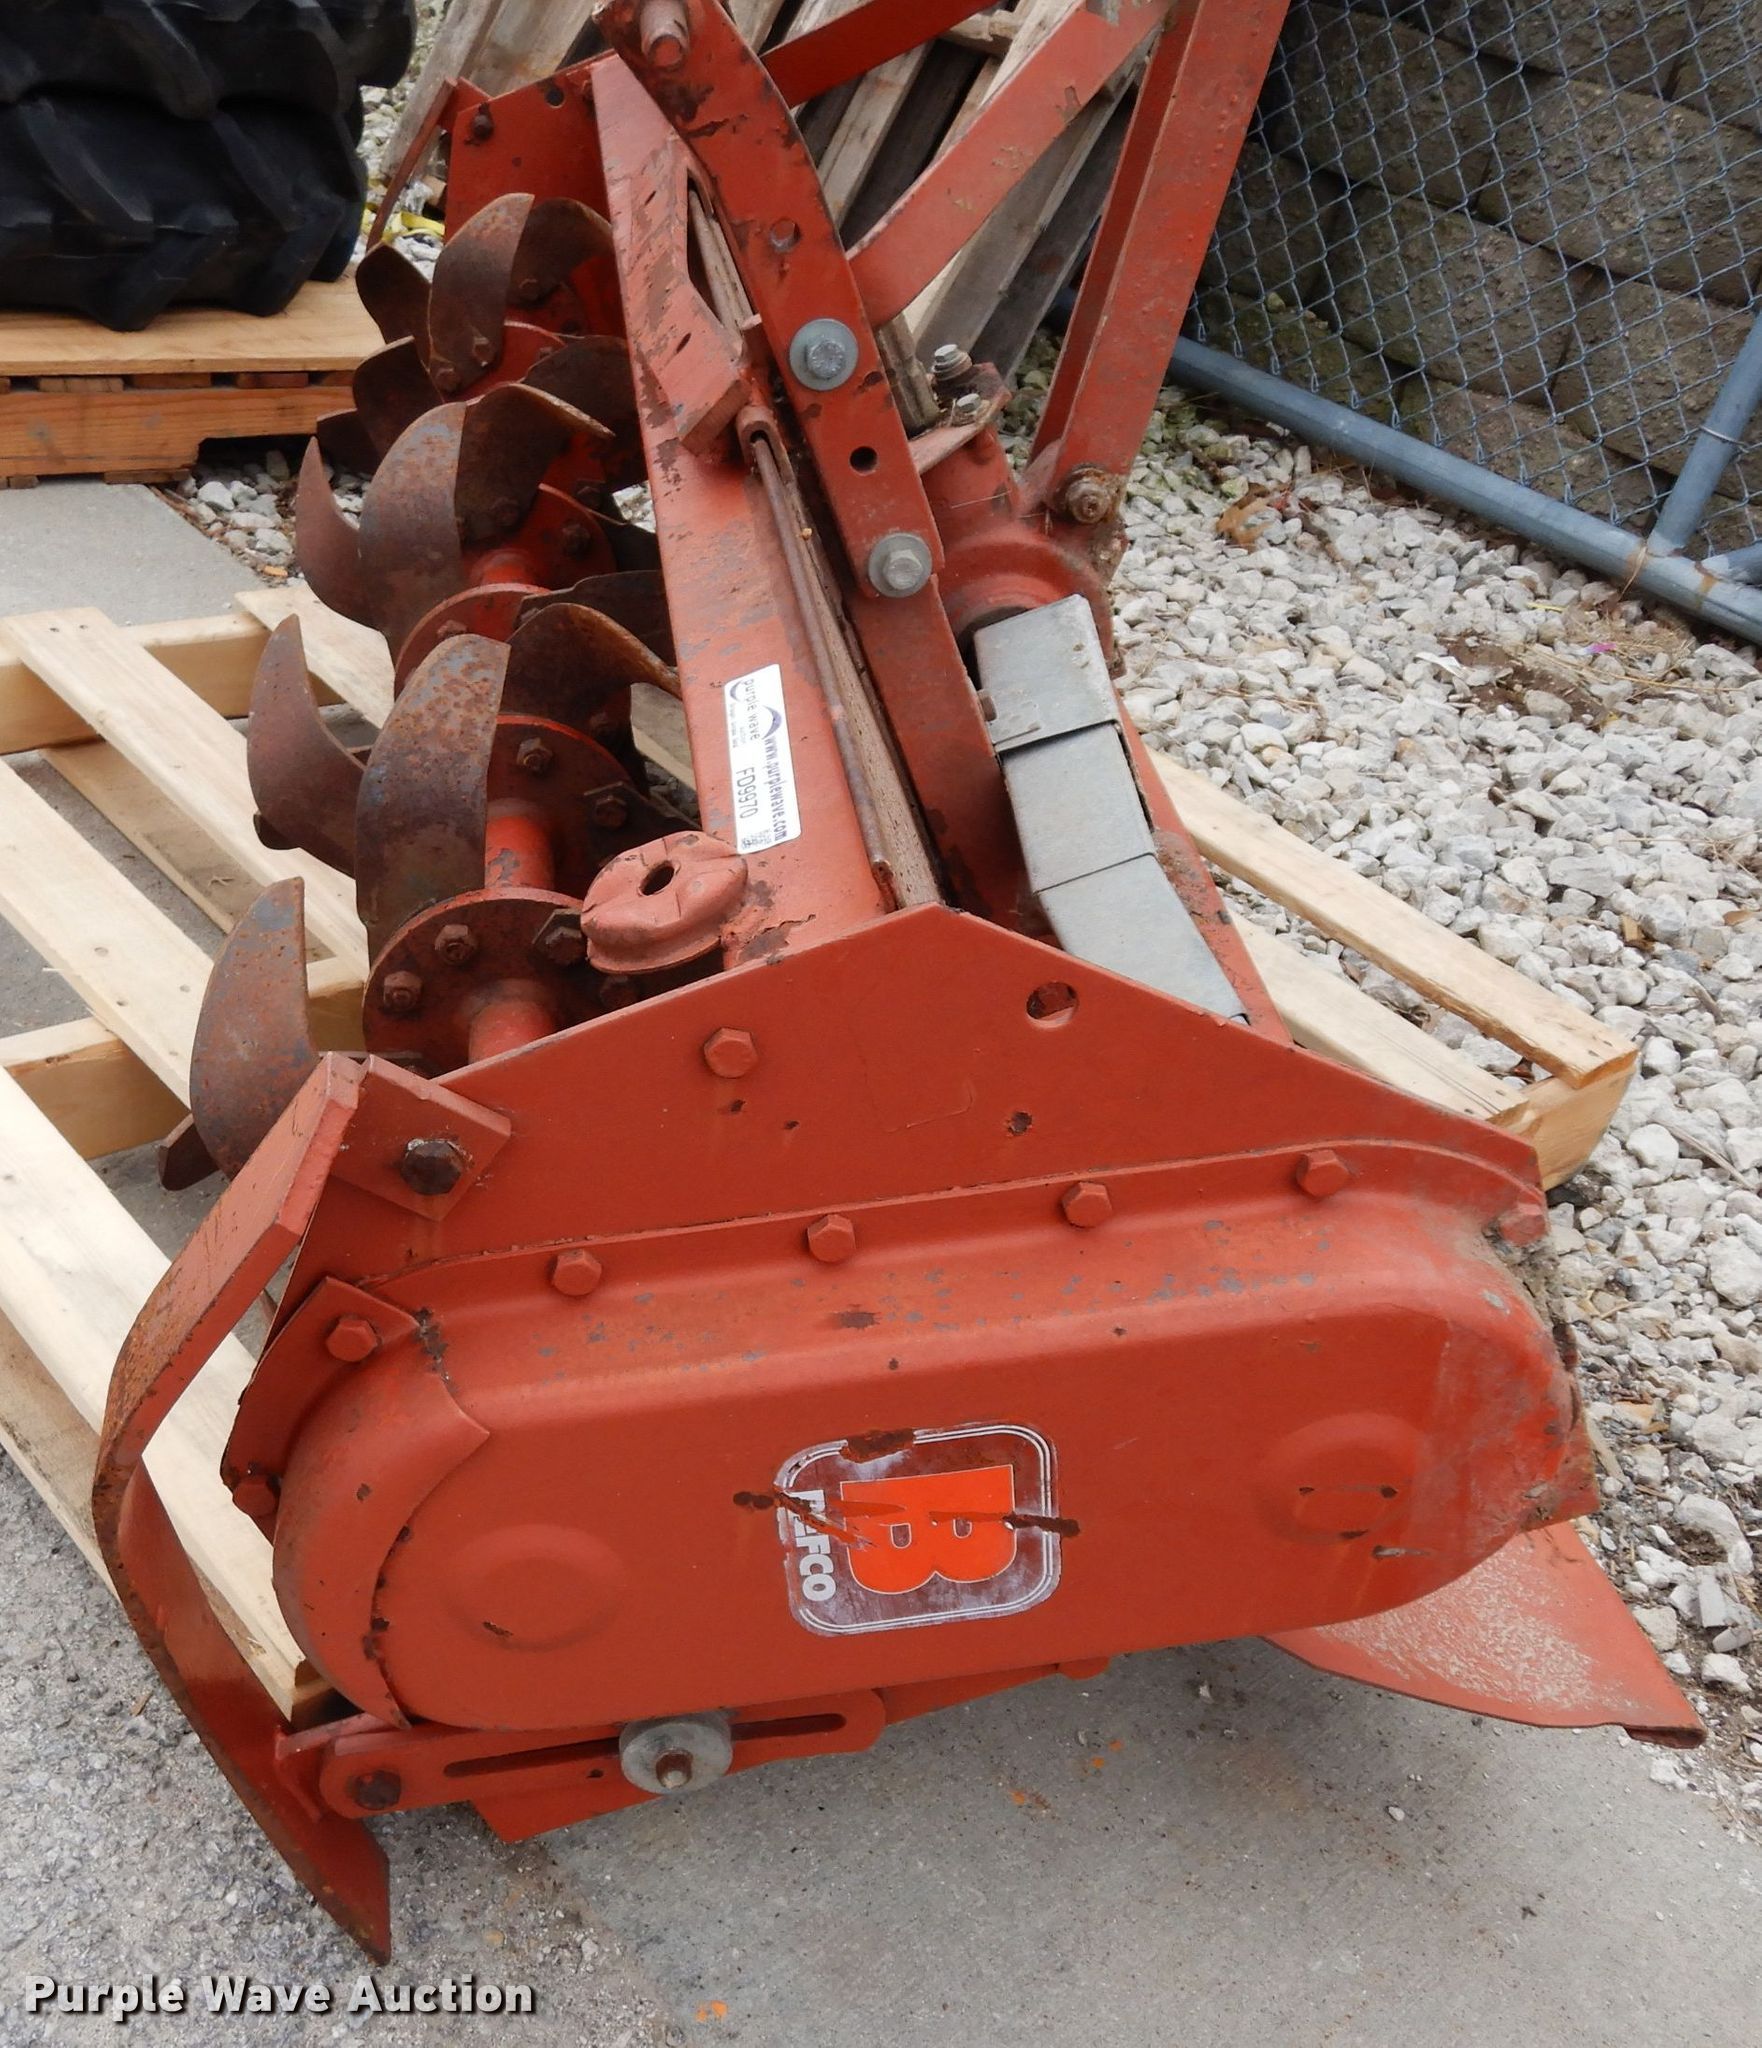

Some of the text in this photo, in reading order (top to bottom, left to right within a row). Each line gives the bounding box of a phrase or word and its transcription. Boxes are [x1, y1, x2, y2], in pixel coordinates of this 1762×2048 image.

[743, 679, 758, 711] purple
[748, 714, 761, 740] wave
[736, 767, 758, 819] FD9970
[763, 736, 788, 841] www.purplewave.com
[840, 1464, 1017, 1594] B
